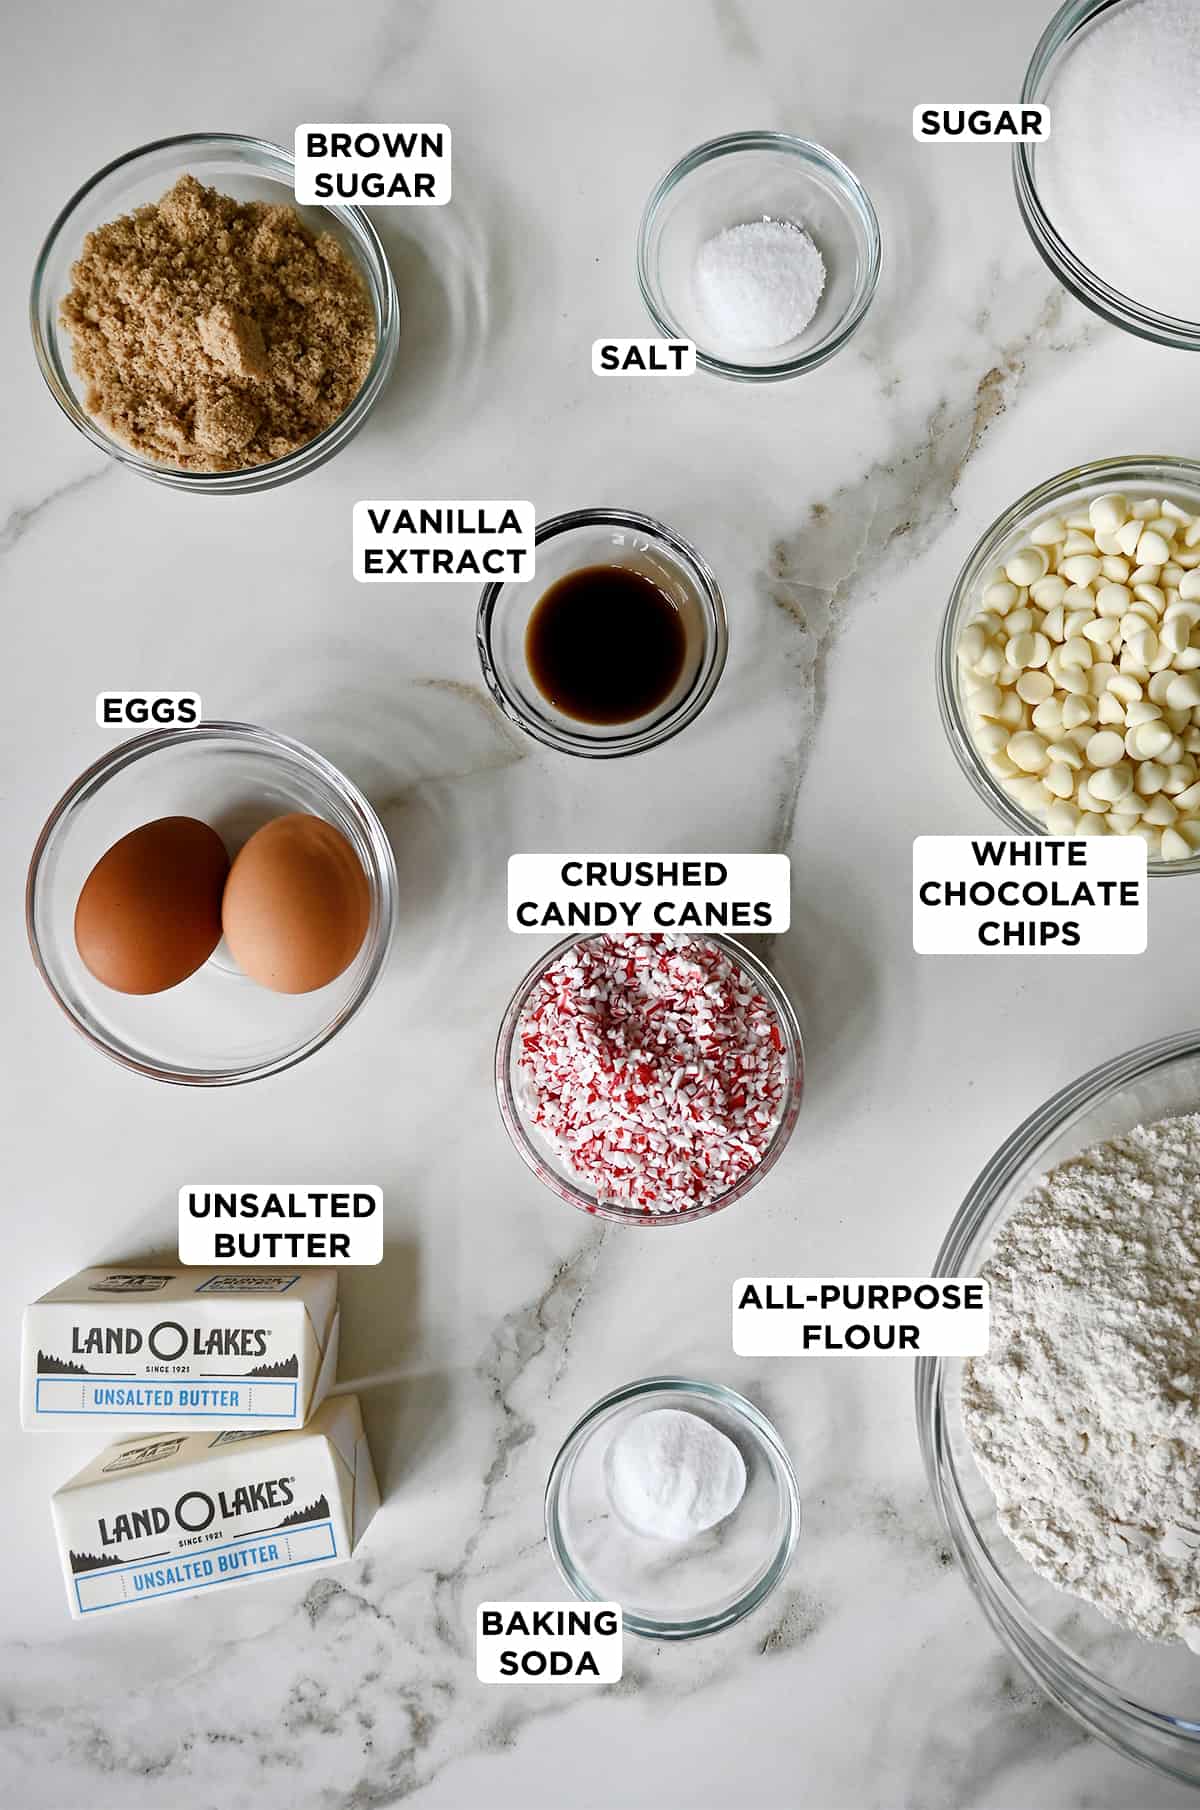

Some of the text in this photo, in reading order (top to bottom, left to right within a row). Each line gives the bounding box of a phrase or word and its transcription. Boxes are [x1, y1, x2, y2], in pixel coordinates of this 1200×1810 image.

[71, 1327, 143, 1354] LAND
[94, 1388, 239, 1407] UNSALTED BUTTER
[98, 1507, 170, 1545] LAND
[178, 1531, 223, 1547] SINCE 1921
[133, 1544, 279, 1591] UNSALTED BUTTER
